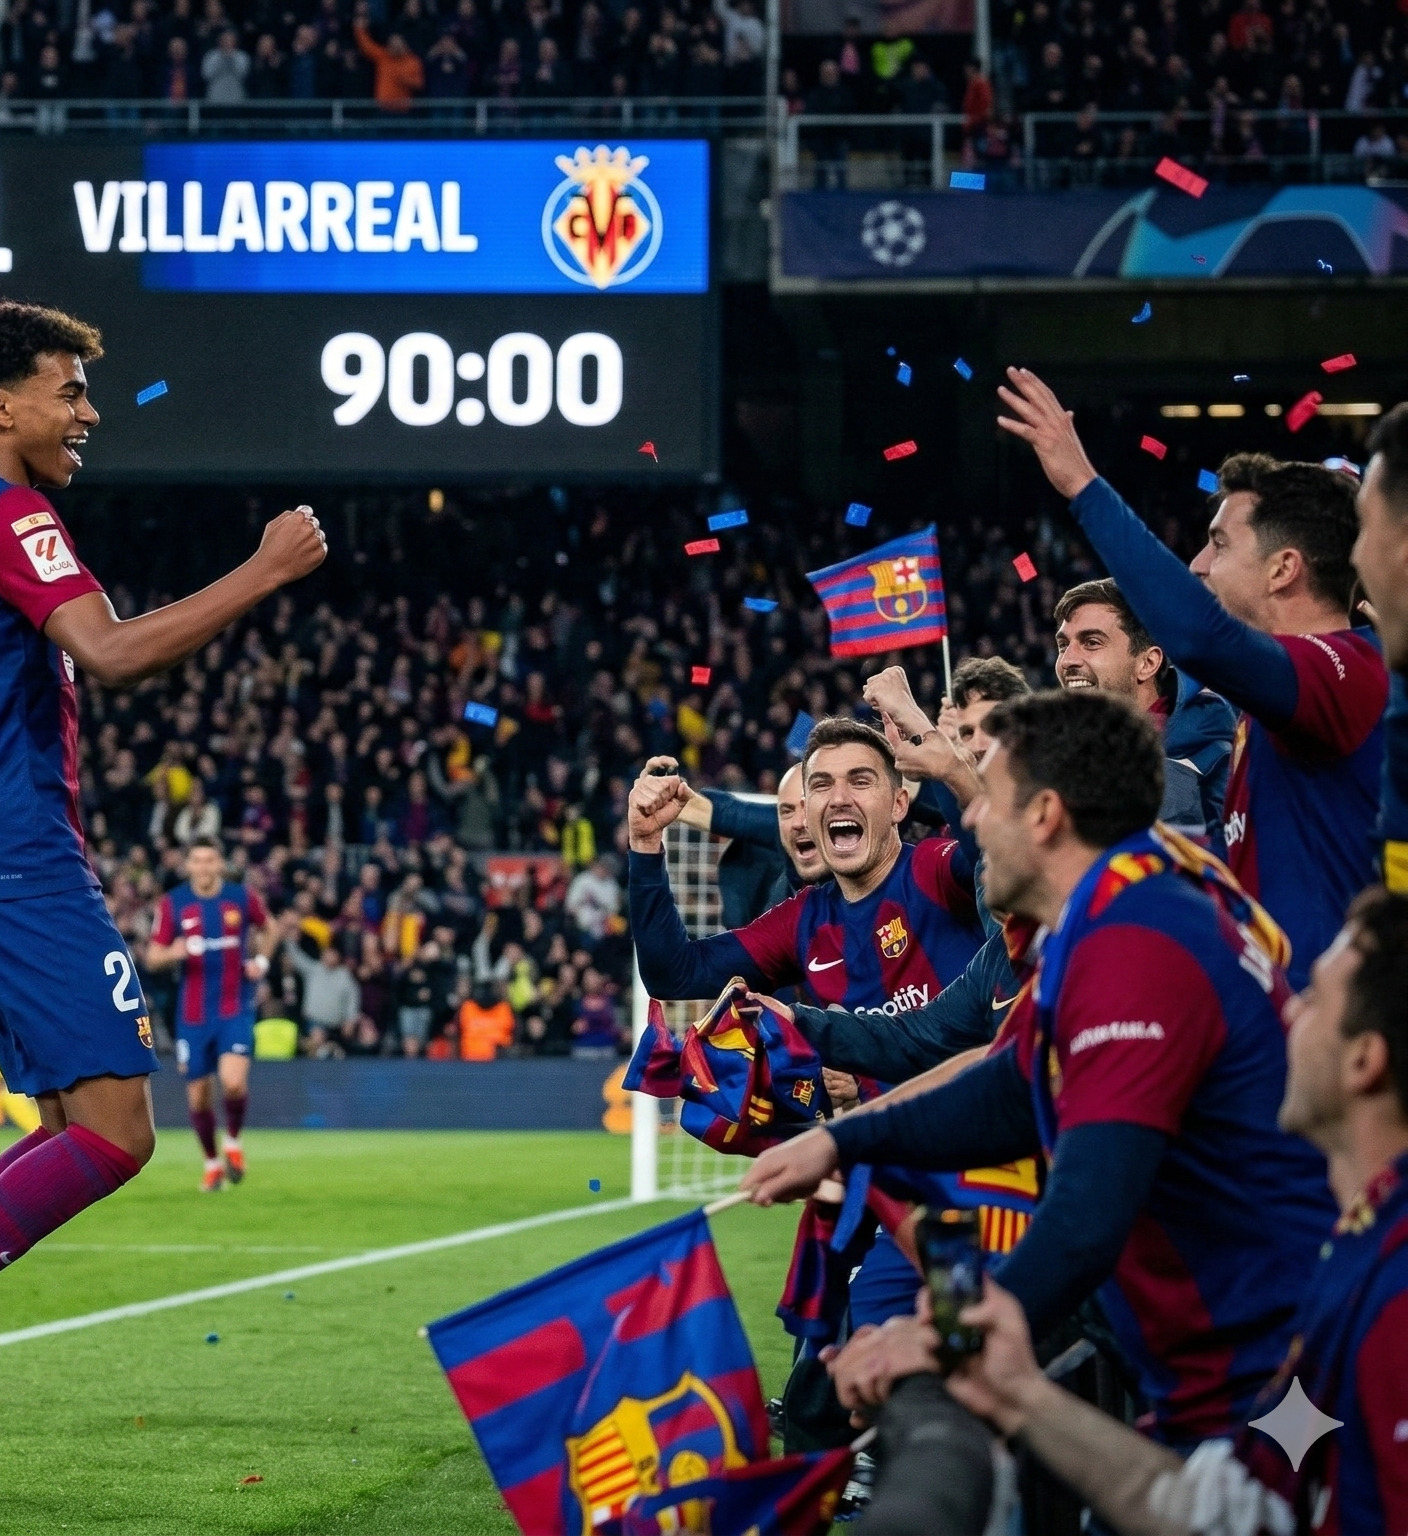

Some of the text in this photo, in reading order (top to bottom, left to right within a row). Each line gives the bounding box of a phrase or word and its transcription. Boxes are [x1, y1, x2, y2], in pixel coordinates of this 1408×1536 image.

[72, 179, 479, 254] VILLARREAL
[319, 331, 625, 428] 90:00
[103, 950, 140, 1013] 2
